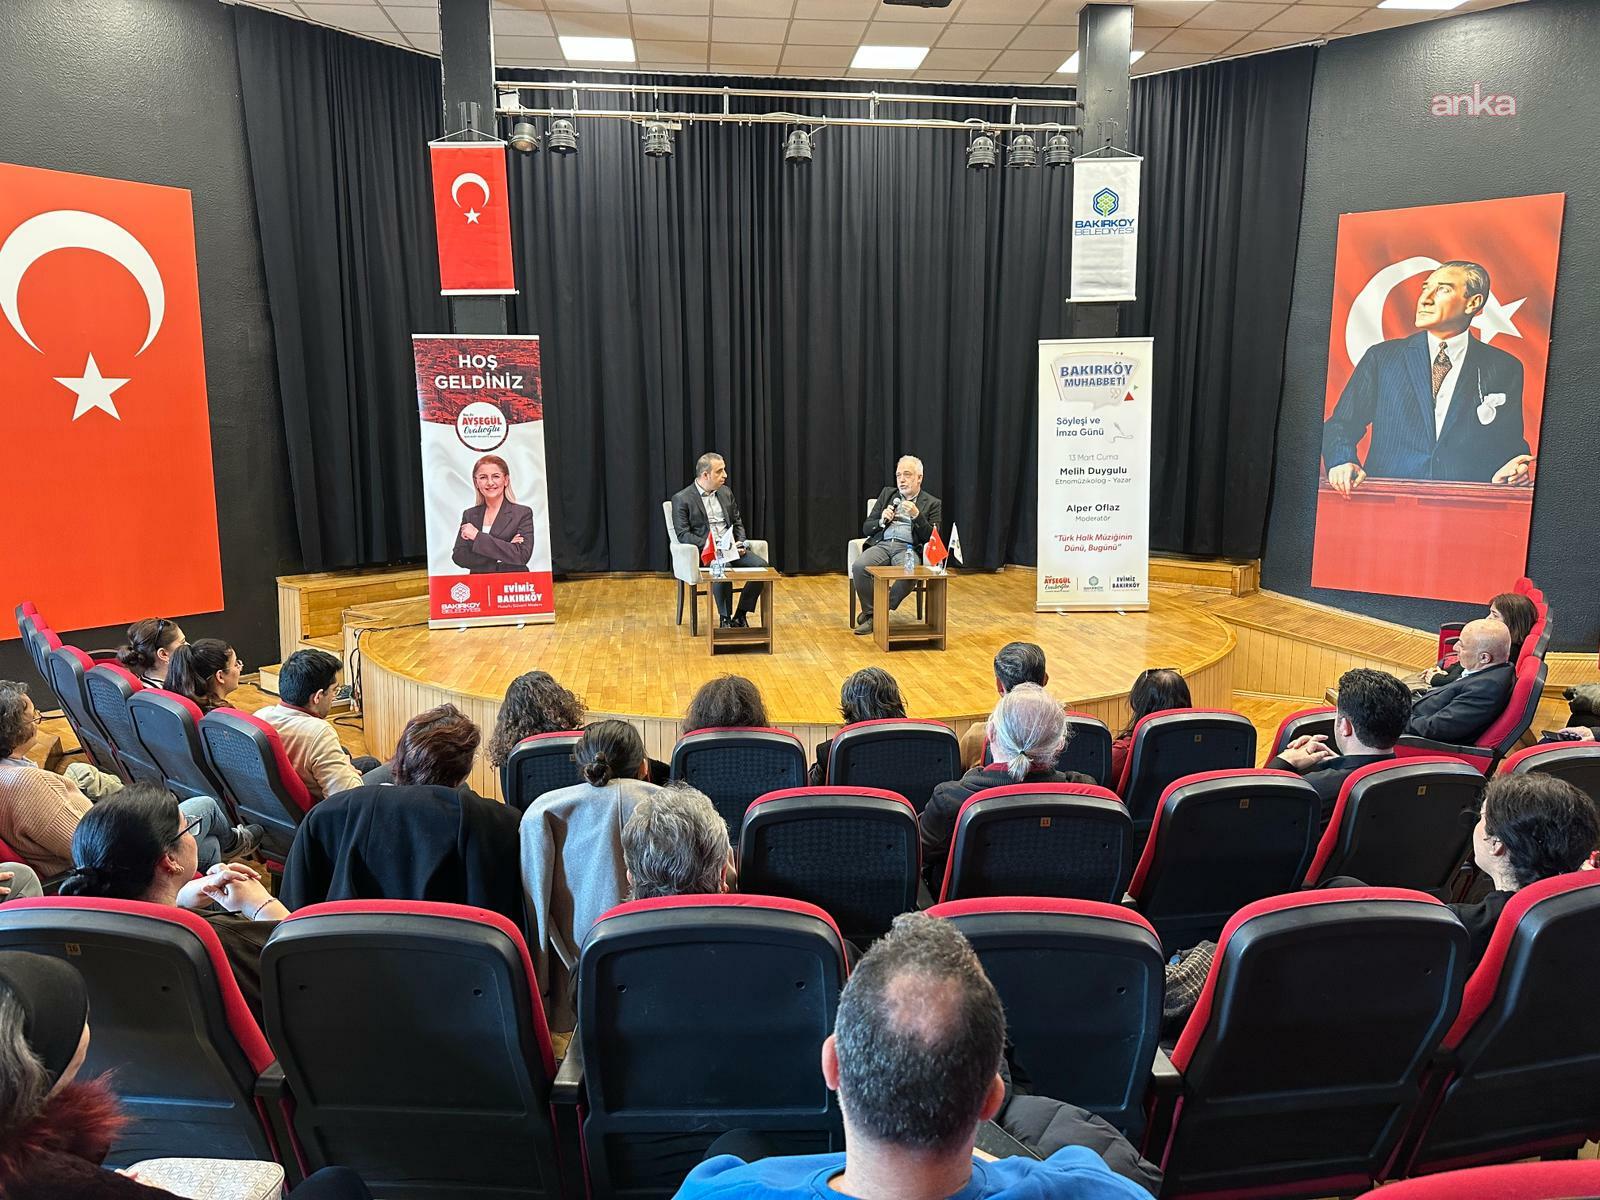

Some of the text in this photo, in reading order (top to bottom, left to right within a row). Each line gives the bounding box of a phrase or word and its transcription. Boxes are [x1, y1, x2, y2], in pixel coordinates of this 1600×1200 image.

[458, 354, 498, 371] HOŞ
[1060, 361, 1133, 377] BAKIRKÖY
[434, 372, 524, 389] GELDİNİZ
[1064, 376, 1126, 387] MUHABBETİ
[1056, 417, 1088, 427] Söyleşi
[1056, 427, 1104, 437] İmza Günü
[1096, 453, 1119, 461] Cuma
[1060, 466, 1127, 475] Melih Duygulu
[1066, 503, 1120, 513] Alper Oflaz
[1075, 533, 1094, 541] Halk
[1094, 533, 1133, 542] Müziğinin
[1064, 544, 1087, 552] Dünü,
[504, 582, 534, 593] EVİMİZ
[497, 592, 543, 603] BAKIRKÖY
